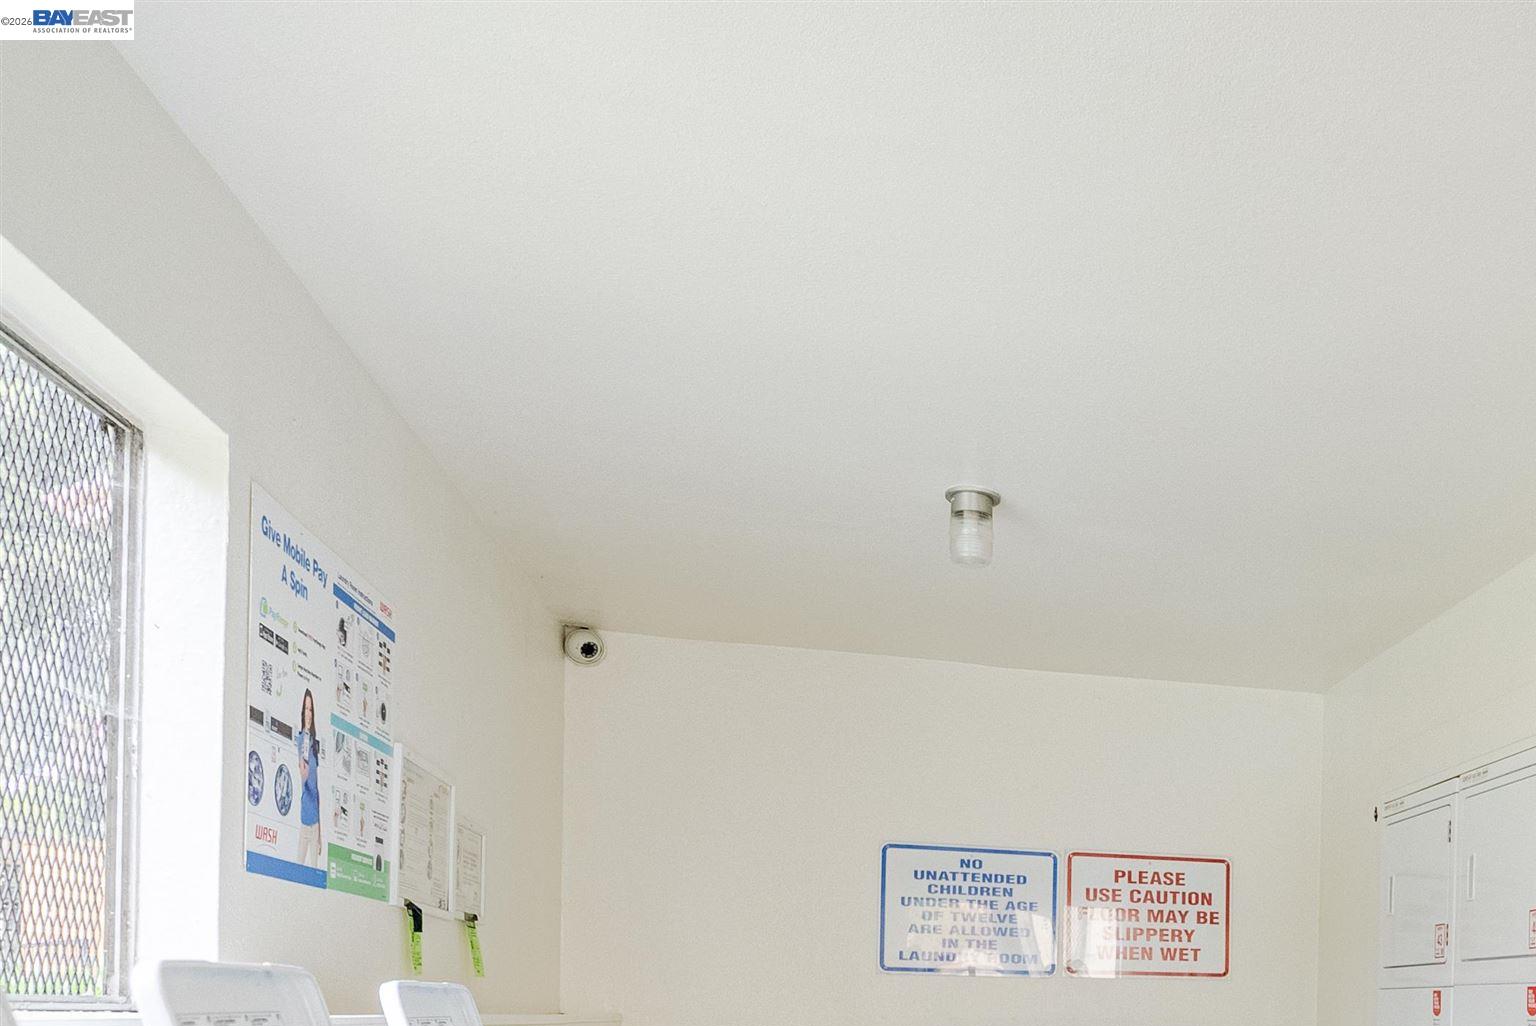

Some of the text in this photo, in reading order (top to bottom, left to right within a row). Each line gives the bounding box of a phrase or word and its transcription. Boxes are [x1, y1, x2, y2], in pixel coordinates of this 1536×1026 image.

[261, 515, 328, 588] Give Mobile Pay
[282, 564, 308, 600] A Spin
[255, 824, 278, 845] WASH
[960, 858, 983, 869] NO
[914, 870, 1027, 885] UNATTENDED
[1114, 869, 1185, 886] PLEASE
[928, 883, 1013, 897] CHILDREN
[1085, 887, 1212, 906] USE CAUTION
[901, 896, 1039, 912] UNDER THE AGE
[921, 910, 1017, 924] OF TWELVE
[1147, 909, 1189, 924] MAY
[1196, 911, 1219, 925] BE
[908, 924, 1030, 938] ARE ALLOWED
[1103, 927, 1195, 943] SLIPPERY
[942, 938, 997, 950] IN THE
[1098, 945, 1201, 961] WHEN WET
